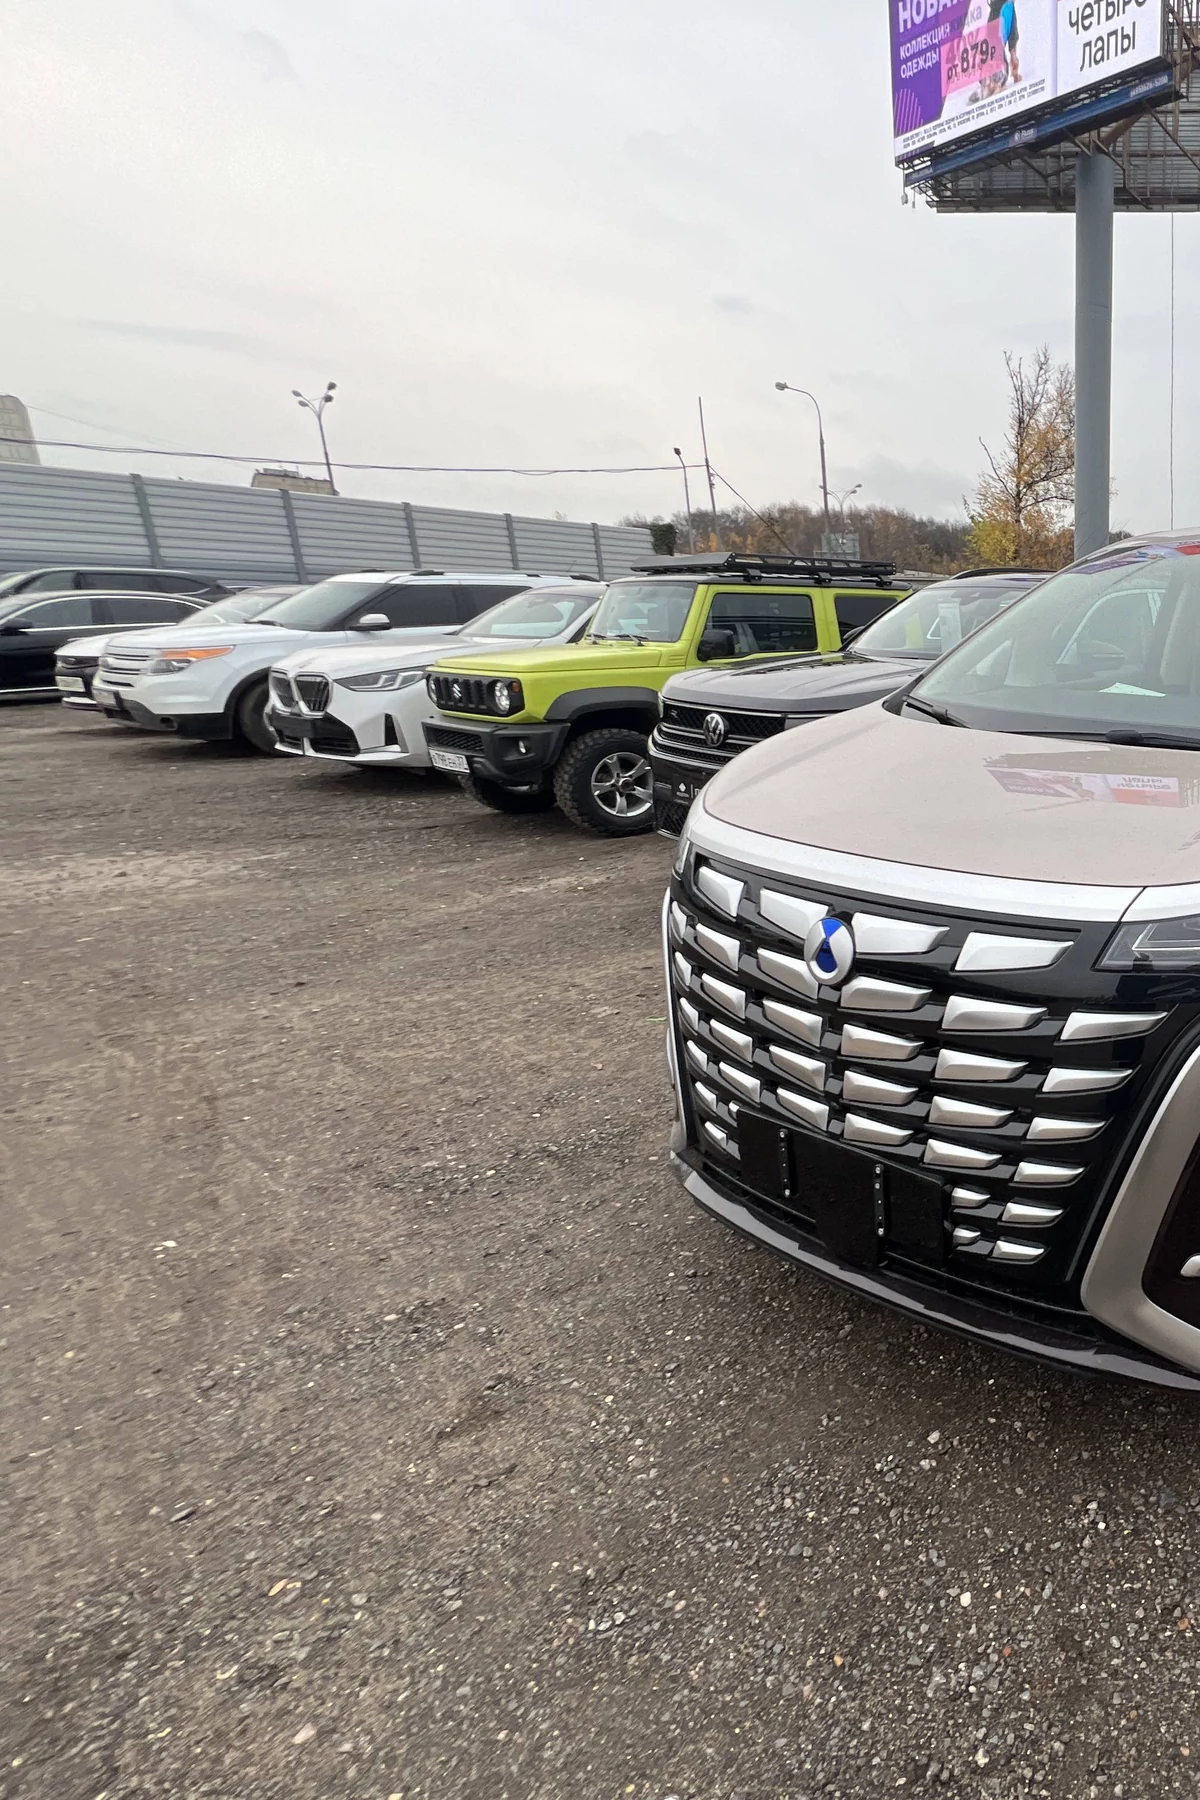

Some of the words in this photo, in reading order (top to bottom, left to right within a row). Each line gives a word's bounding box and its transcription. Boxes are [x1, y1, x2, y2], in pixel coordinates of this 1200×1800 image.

[898, 0, 963, 33] НОВ
[1068, 0, 1148, 35] четыр
[900, 22, 951, 60] КОЛЛЕКЦИЯ
[1080, 21, 1136, 72] лапы
[900, 48, 940, 79] ОДЕЖДЫ
[947, 63, 959, 81] от
